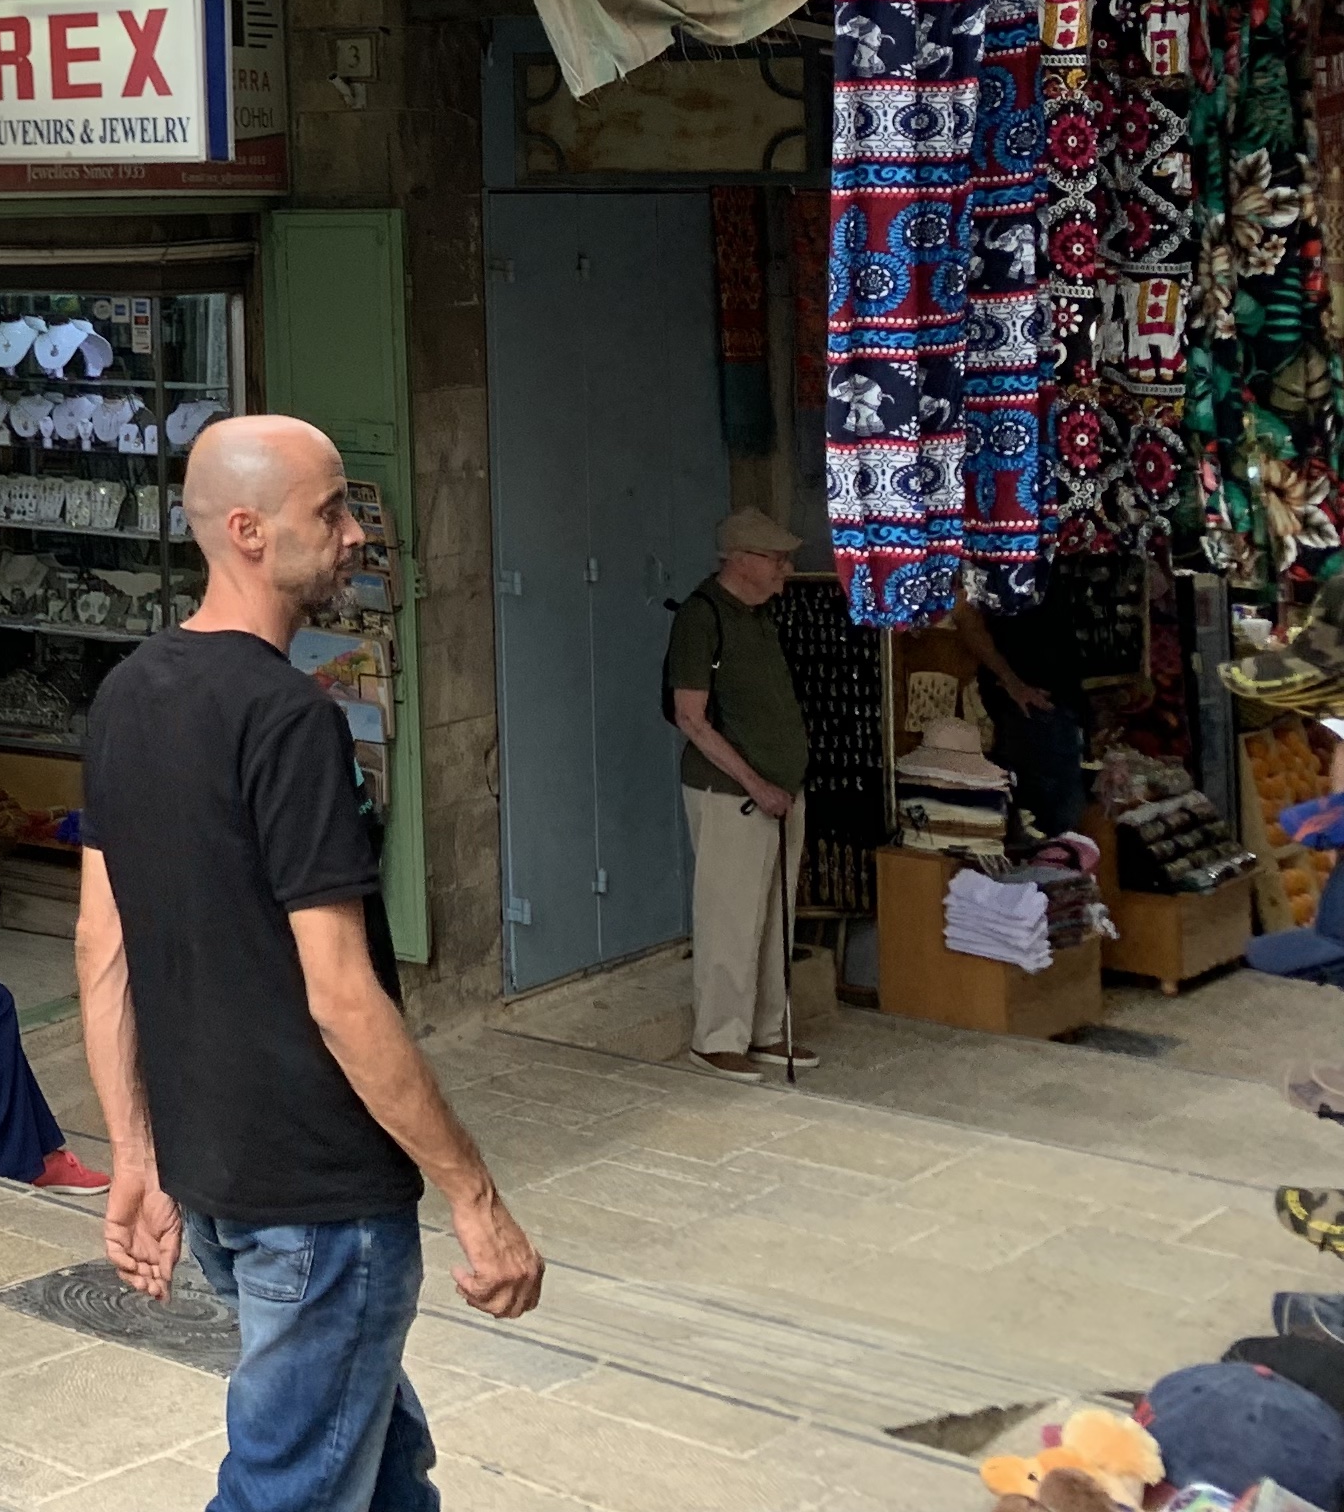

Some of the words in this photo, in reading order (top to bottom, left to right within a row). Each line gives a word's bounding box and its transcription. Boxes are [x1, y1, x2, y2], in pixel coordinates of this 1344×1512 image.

[348, 45, 361, 70] 3
[79, 120, 95, 144] &
[98, 115, 191, 144] JEWELRY
